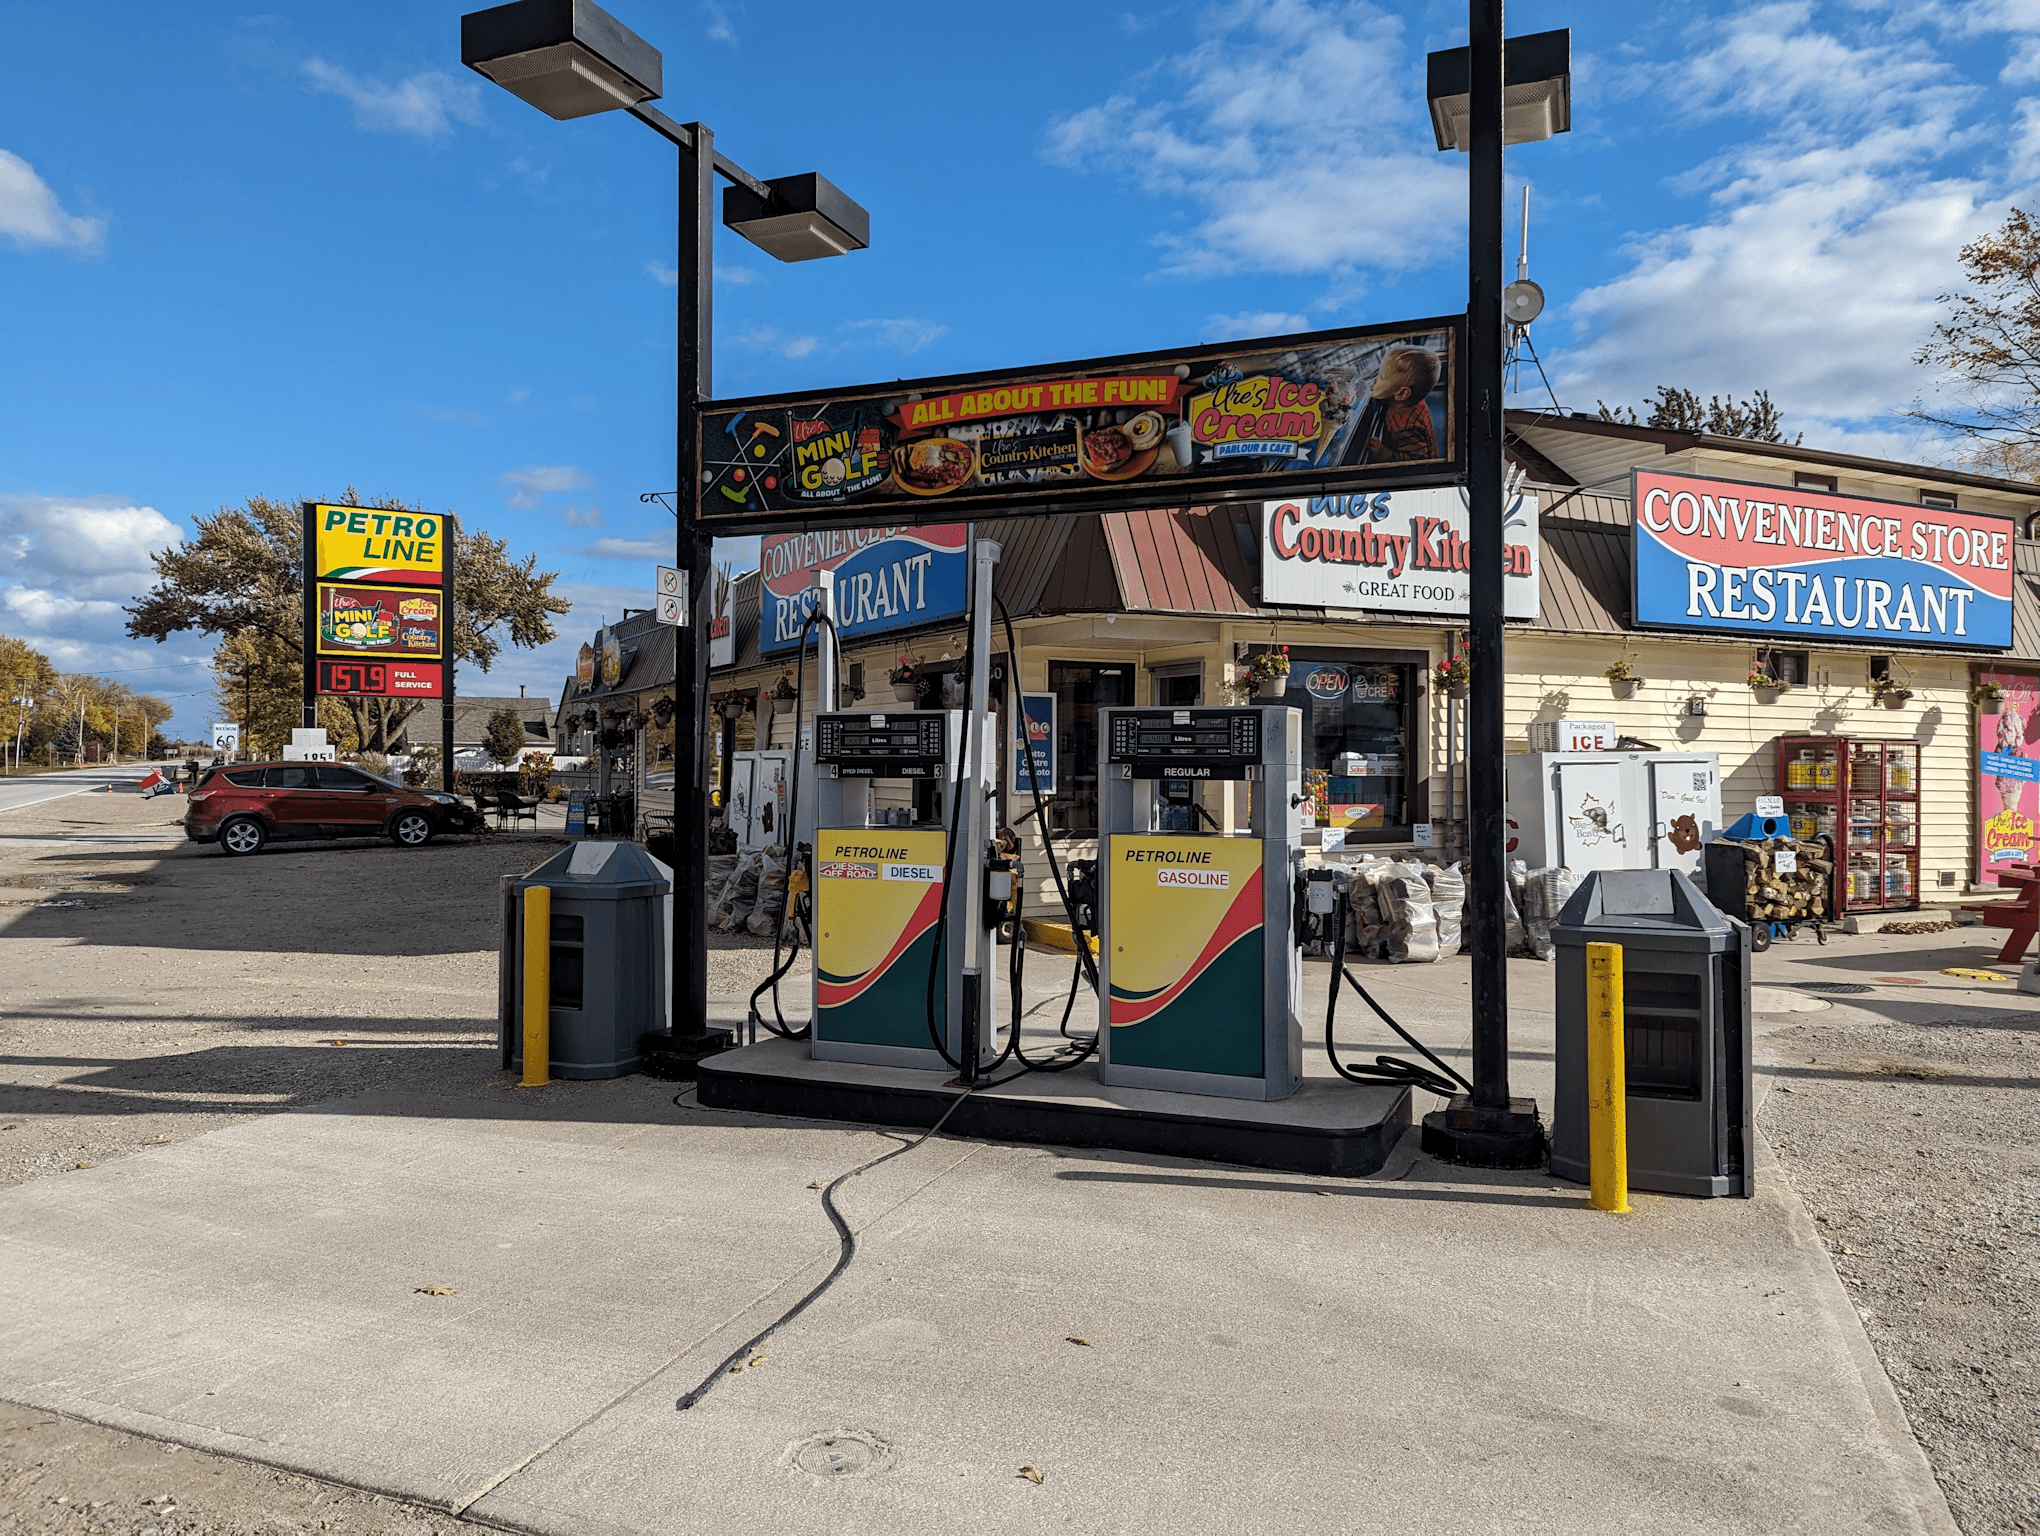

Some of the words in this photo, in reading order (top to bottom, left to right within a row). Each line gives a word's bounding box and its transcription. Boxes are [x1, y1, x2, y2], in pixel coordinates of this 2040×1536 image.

[1212, 382, 1267, 412] Ure's
[1262, 376, 1321, 410] Ice
[912, 399, 954, 425] ALL
[960, 386, 1044, 416] ABOUT
[1049, 382, 1098, 406] THE
[1104, 380, 1167, 402] FUN!
[794, 419, 825, 440] Ure's
[1194, 407, 1319, 442] Cream
[797, 430, 850, 466] MINI
[1219, 443, 1258, 454] PARLOUR
[1260, 444, 1268, 453] &
[1270, 443, 1292, 453] CAFE
[802, 452, 878, 489] GOLF
[816, 489, 840, 497] ABOUT
[847, 484, 861, 493] THE
[862, 473, 882, 488] FUN!
[325, 510, 437, 539] PETRO
[1644, 488, 1903, 558] CONVENIENCE
[1911, 521, 2008, 570] STORE
[1274, 503, 1410, 576] Country
[363, 538, 435, 562] LINE
[1359, 581, 1408, 598] GREAT
[1413, 585, 1455, 601] FOOD
[1686, 563, 1974, 636] RESTAURANT
[334, 610, 372, 622] MINI
[336, 623, 390, 639] GOLF
[402, 633, 432, 642] Country
[1309, 674, 1346, 690] OPEN
[1573, 736, 1603, 749] ICE
[831, 766, 838, 777] 4
[936, 766, 942, 778] 3
[1124, 765, 1130, 777] 2
[1164, 768, 1210, 777] REGULAR
[1247, 766, 1252, 779] 1
[2011, 812, 2028, 830] Ice
[1987, 828, 2030, 849] Cream
[835, 846, 908, 859] PETROLINE
[1126, 850, 1212, 863] PETROLINE
[824, 870, 843, 878] OFF
[846, 870, 875, 878] ROAD
[831, 862, 865, 870] DIESEL
[891, 867, 934, 879] DIESEL
[1158, 872, 1229, 886] GASOLINE
